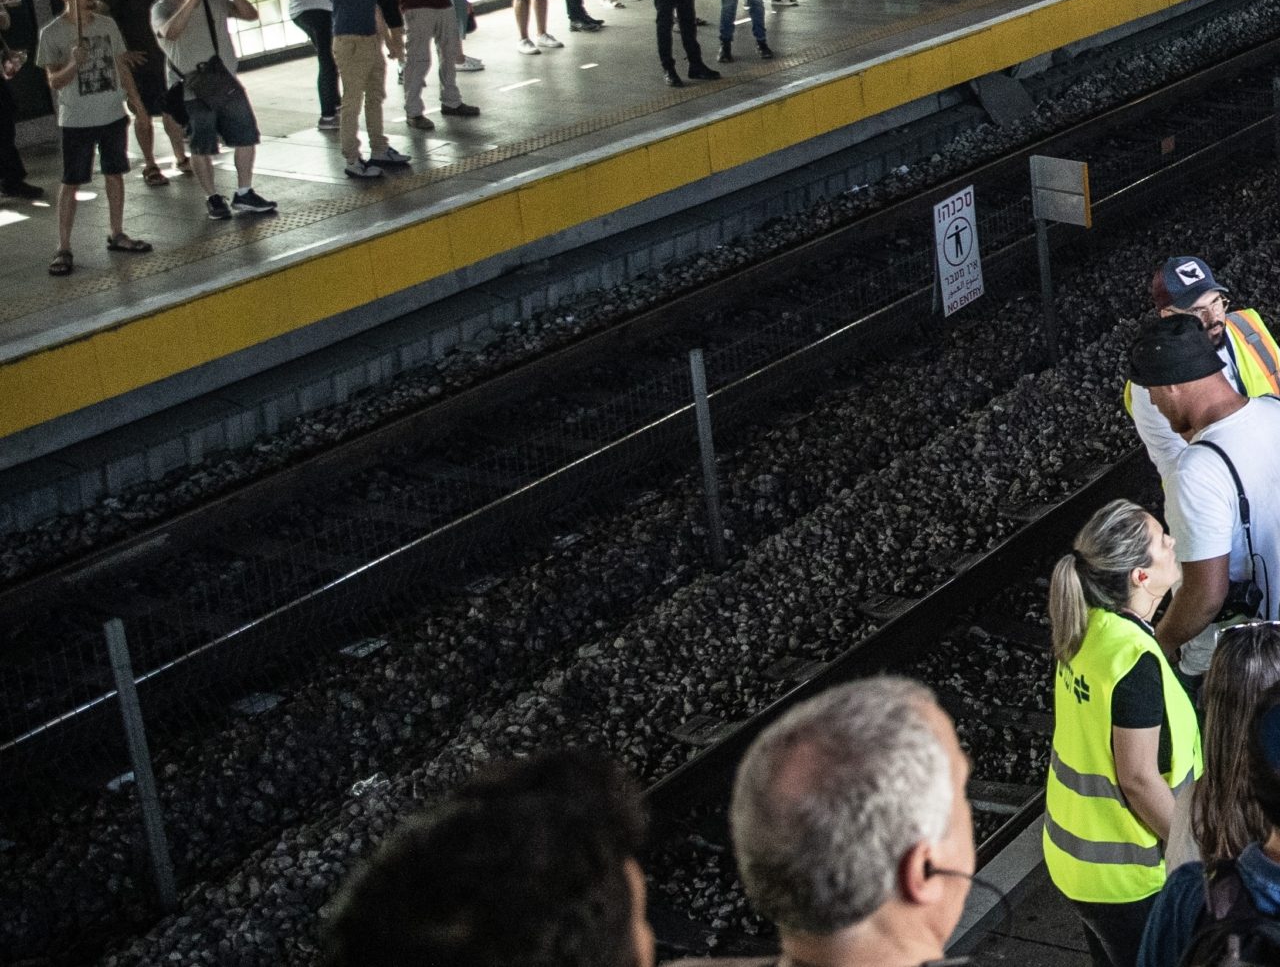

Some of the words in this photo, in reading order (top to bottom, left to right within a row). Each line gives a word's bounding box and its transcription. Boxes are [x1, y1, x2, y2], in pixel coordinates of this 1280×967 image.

[938, 191, 972, 223] סכנה!
[947, 300, 959, 314] NO
[960, 284, 982, 306] ENTRY
